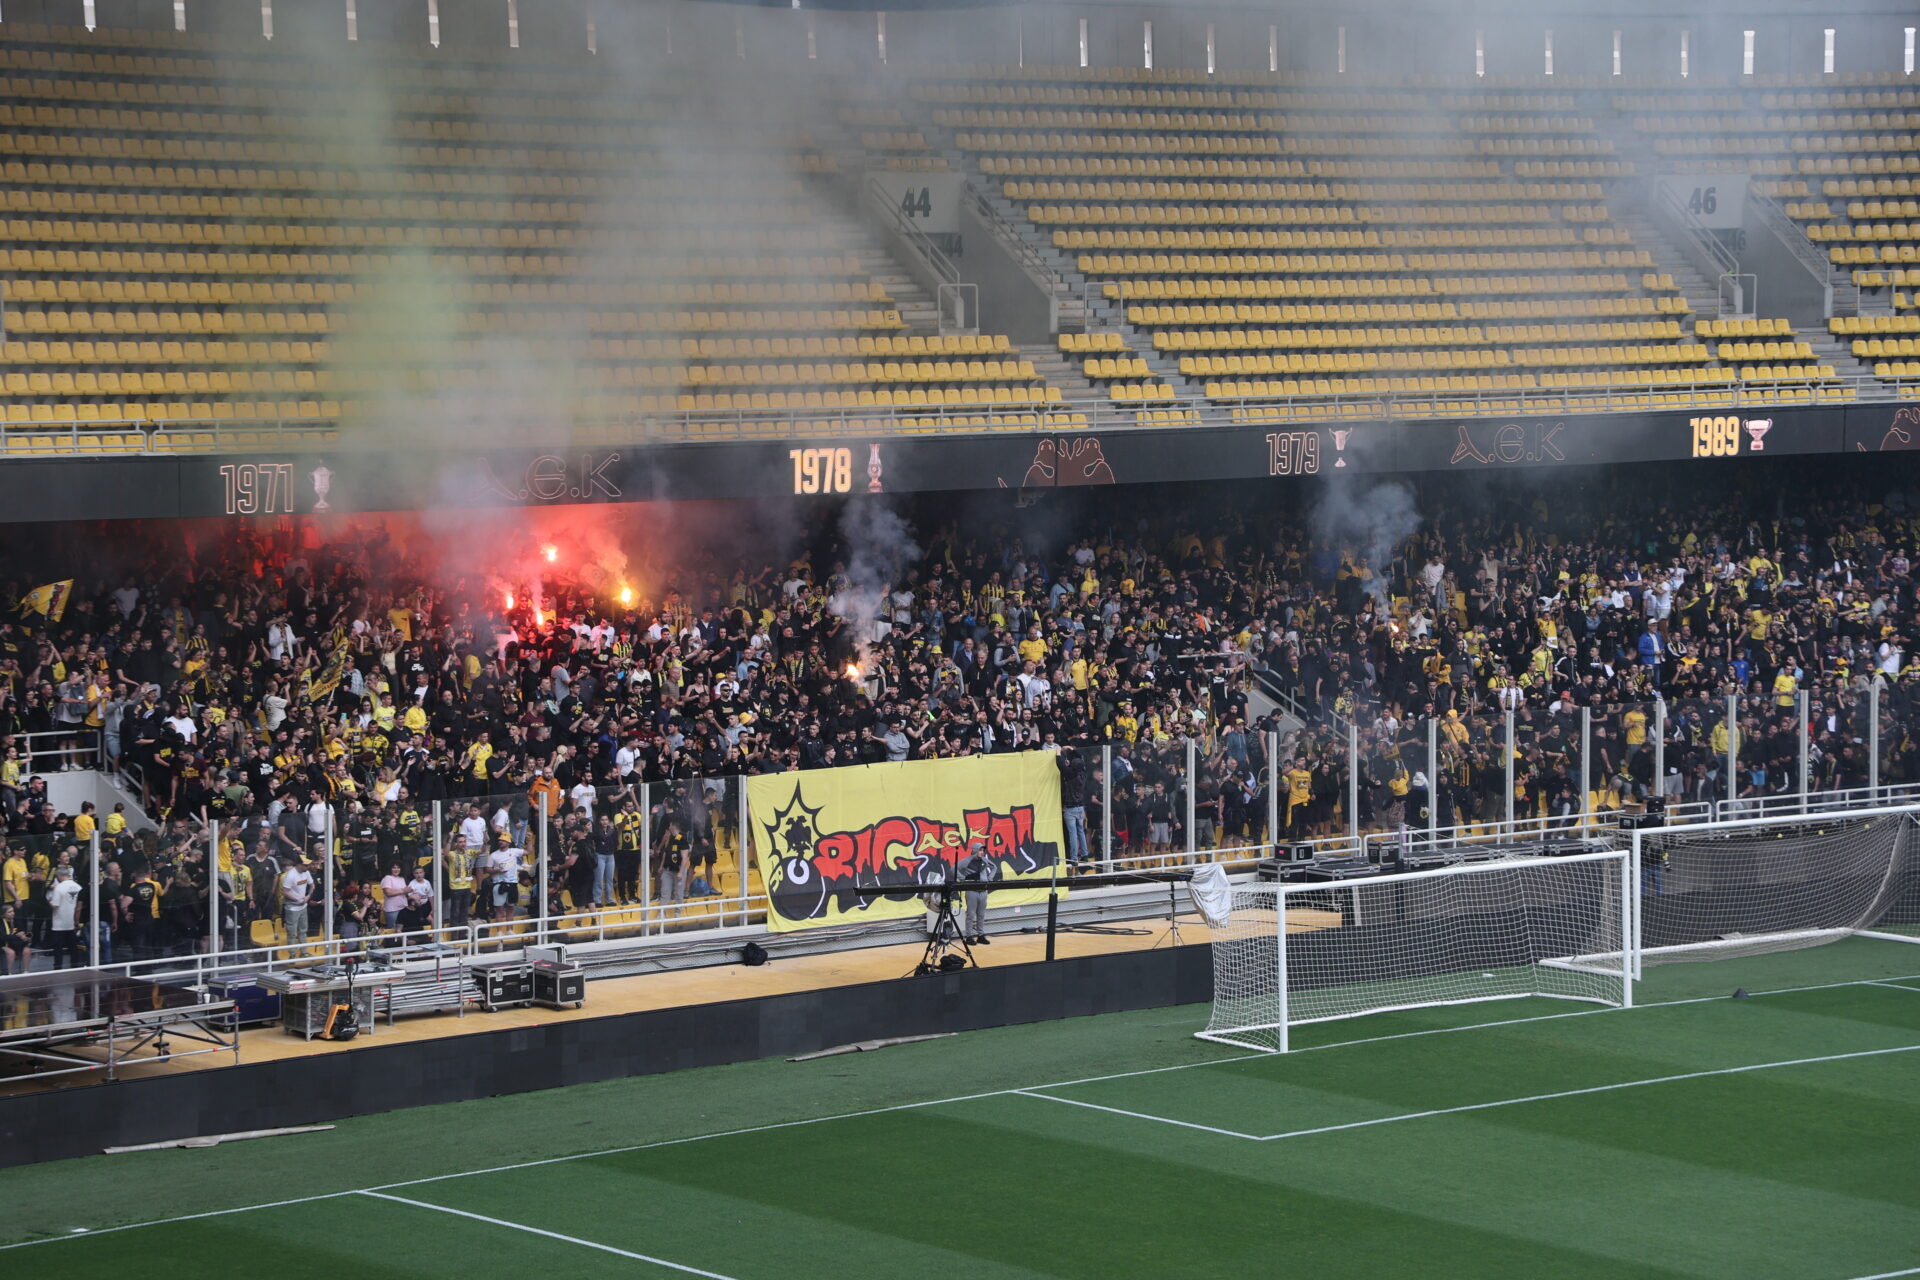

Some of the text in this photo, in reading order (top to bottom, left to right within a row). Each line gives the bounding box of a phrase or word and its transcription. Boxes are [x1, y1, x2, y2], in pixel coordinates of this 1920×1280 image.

[901, 186, 932, 218] 44
[1688, 187, 1717, 215] 46
[1266, 433, 1320, 476] 1979
[1690, 416, 1740, 458] 1989
[220, 463, 294, 514] 1971
[790, 447, 852, 495] 1978
